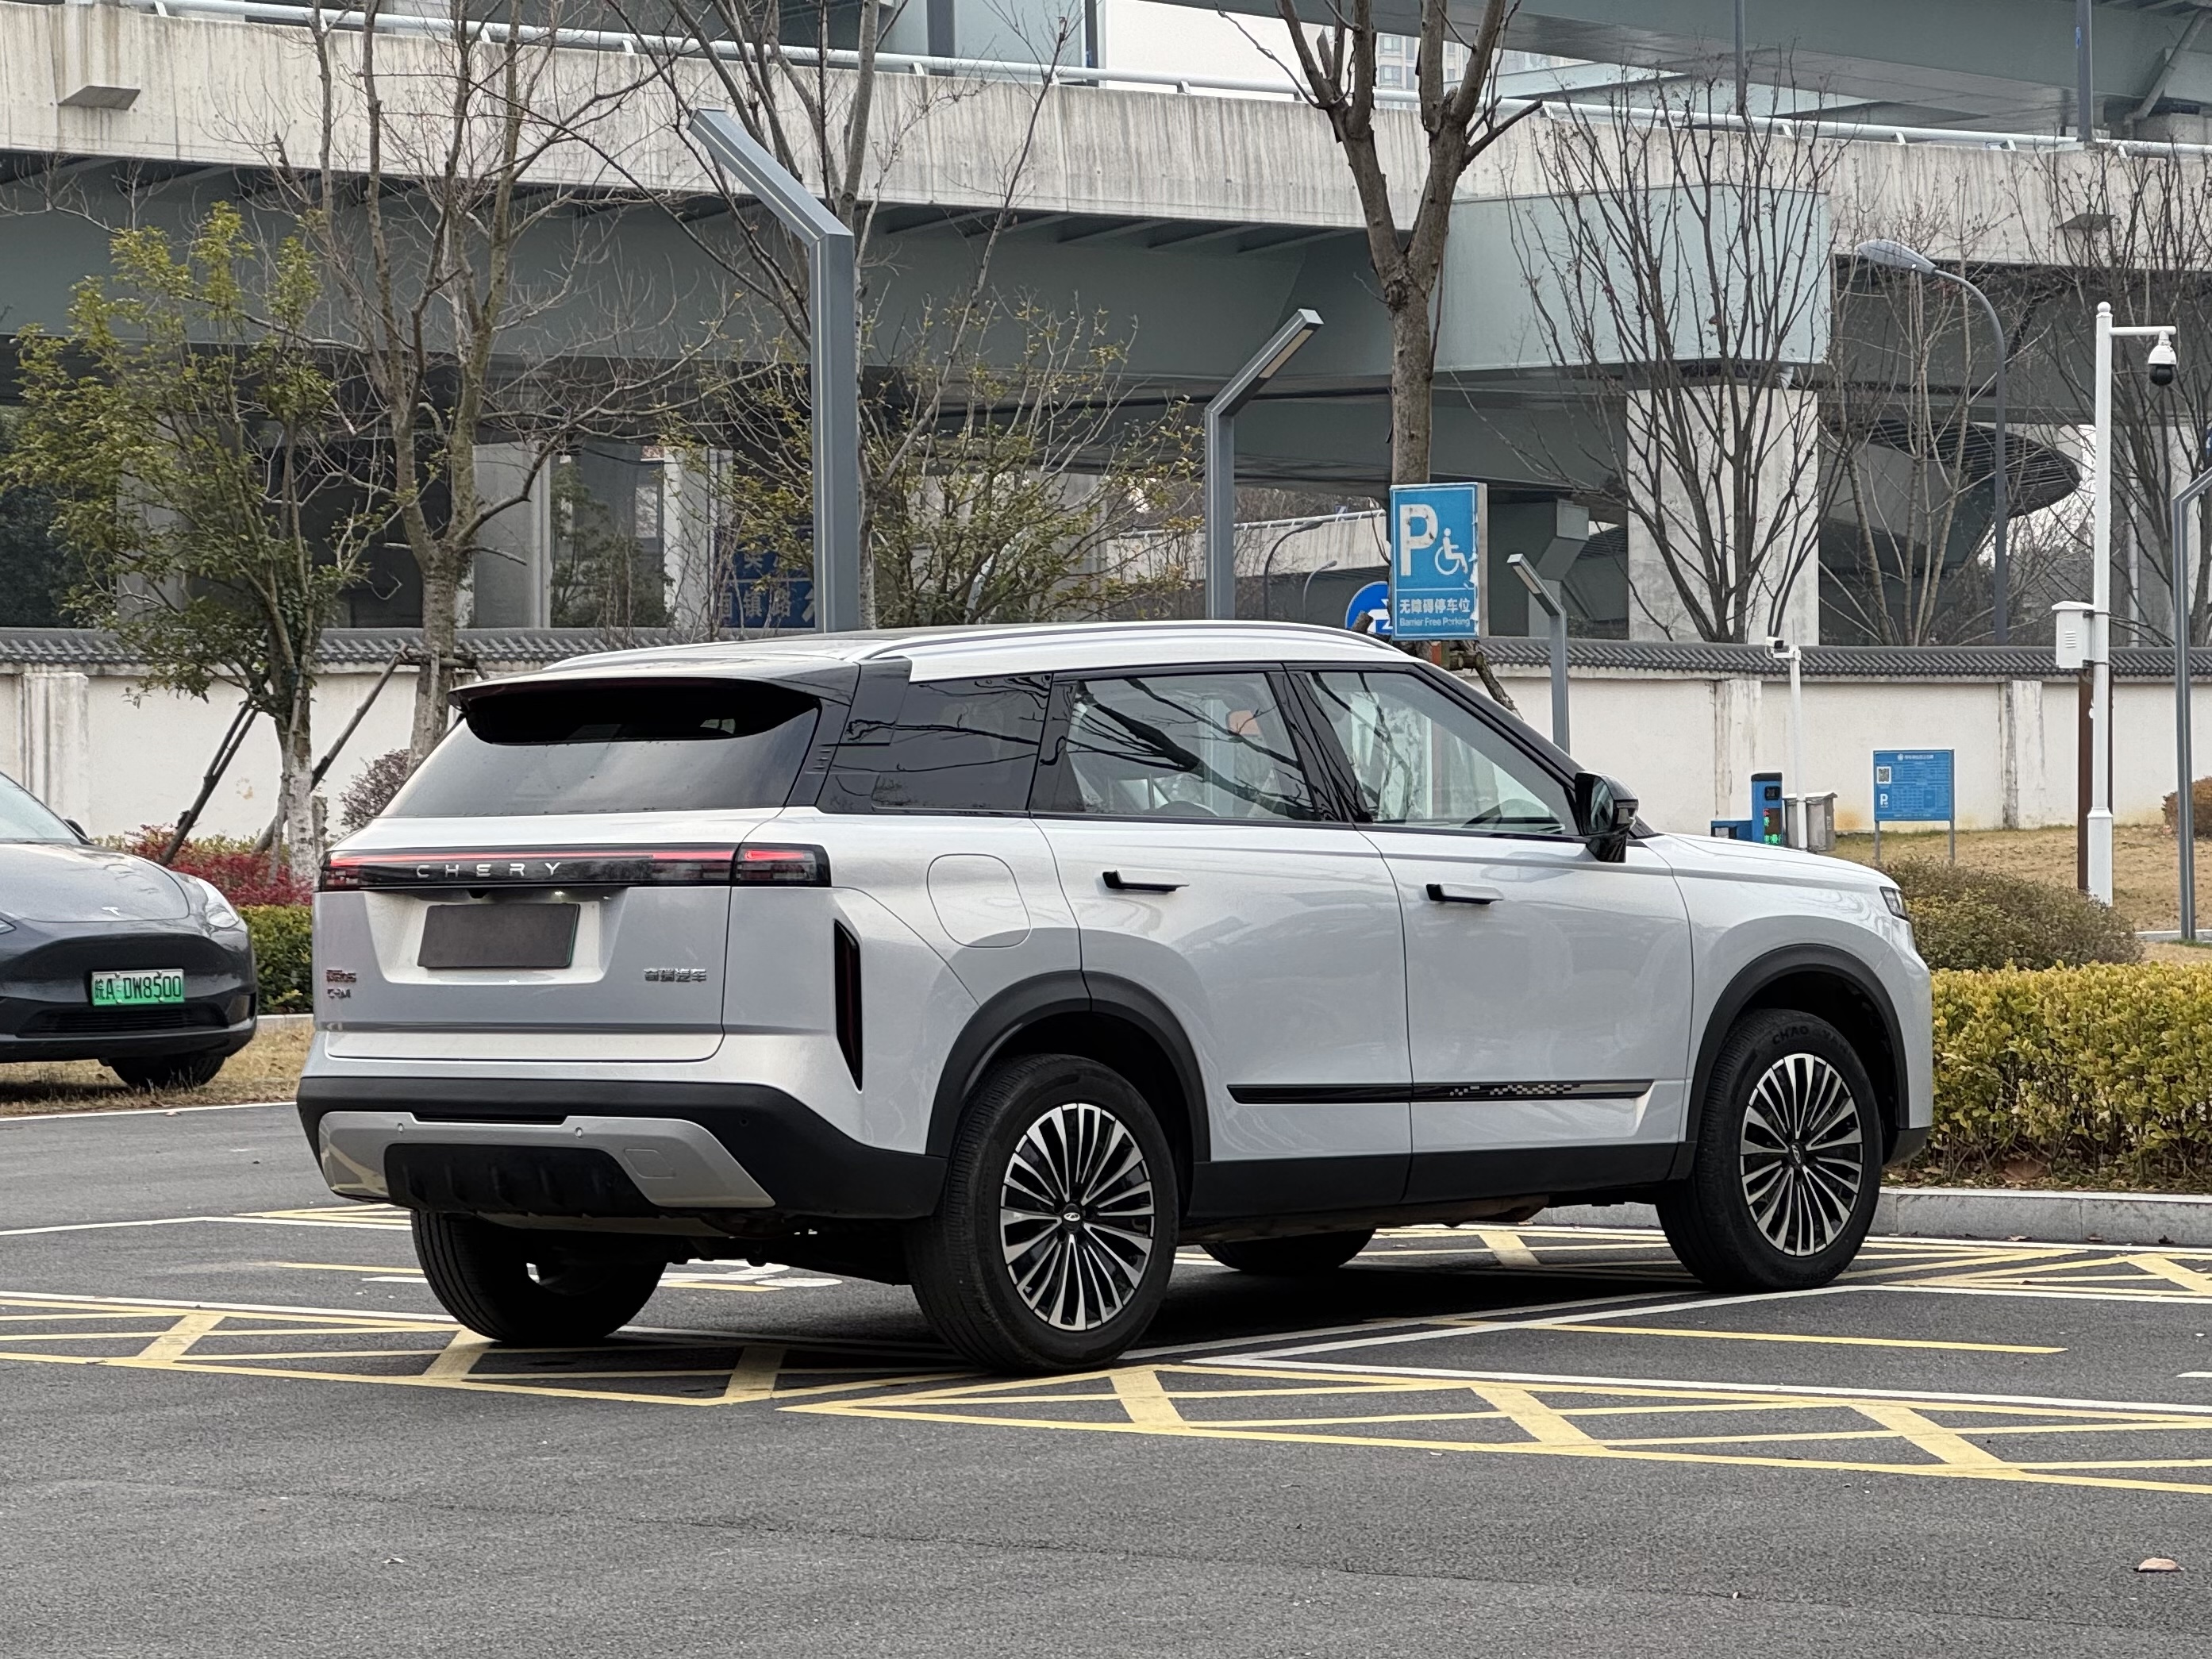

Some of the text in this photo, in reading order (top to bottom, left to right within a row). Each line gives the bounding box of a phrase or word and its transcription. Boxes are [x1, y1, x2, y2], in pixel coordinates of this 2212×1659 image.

[1399, 504, 1438, 576] P
[1399, 598, 1471, 614] 无障碍停车位
[1399, 616, 1471, 628] Barrier Free Parking
[416, 861, 561, 879] CHERY
[1772, 1025, 1810, 1045] CHAO
